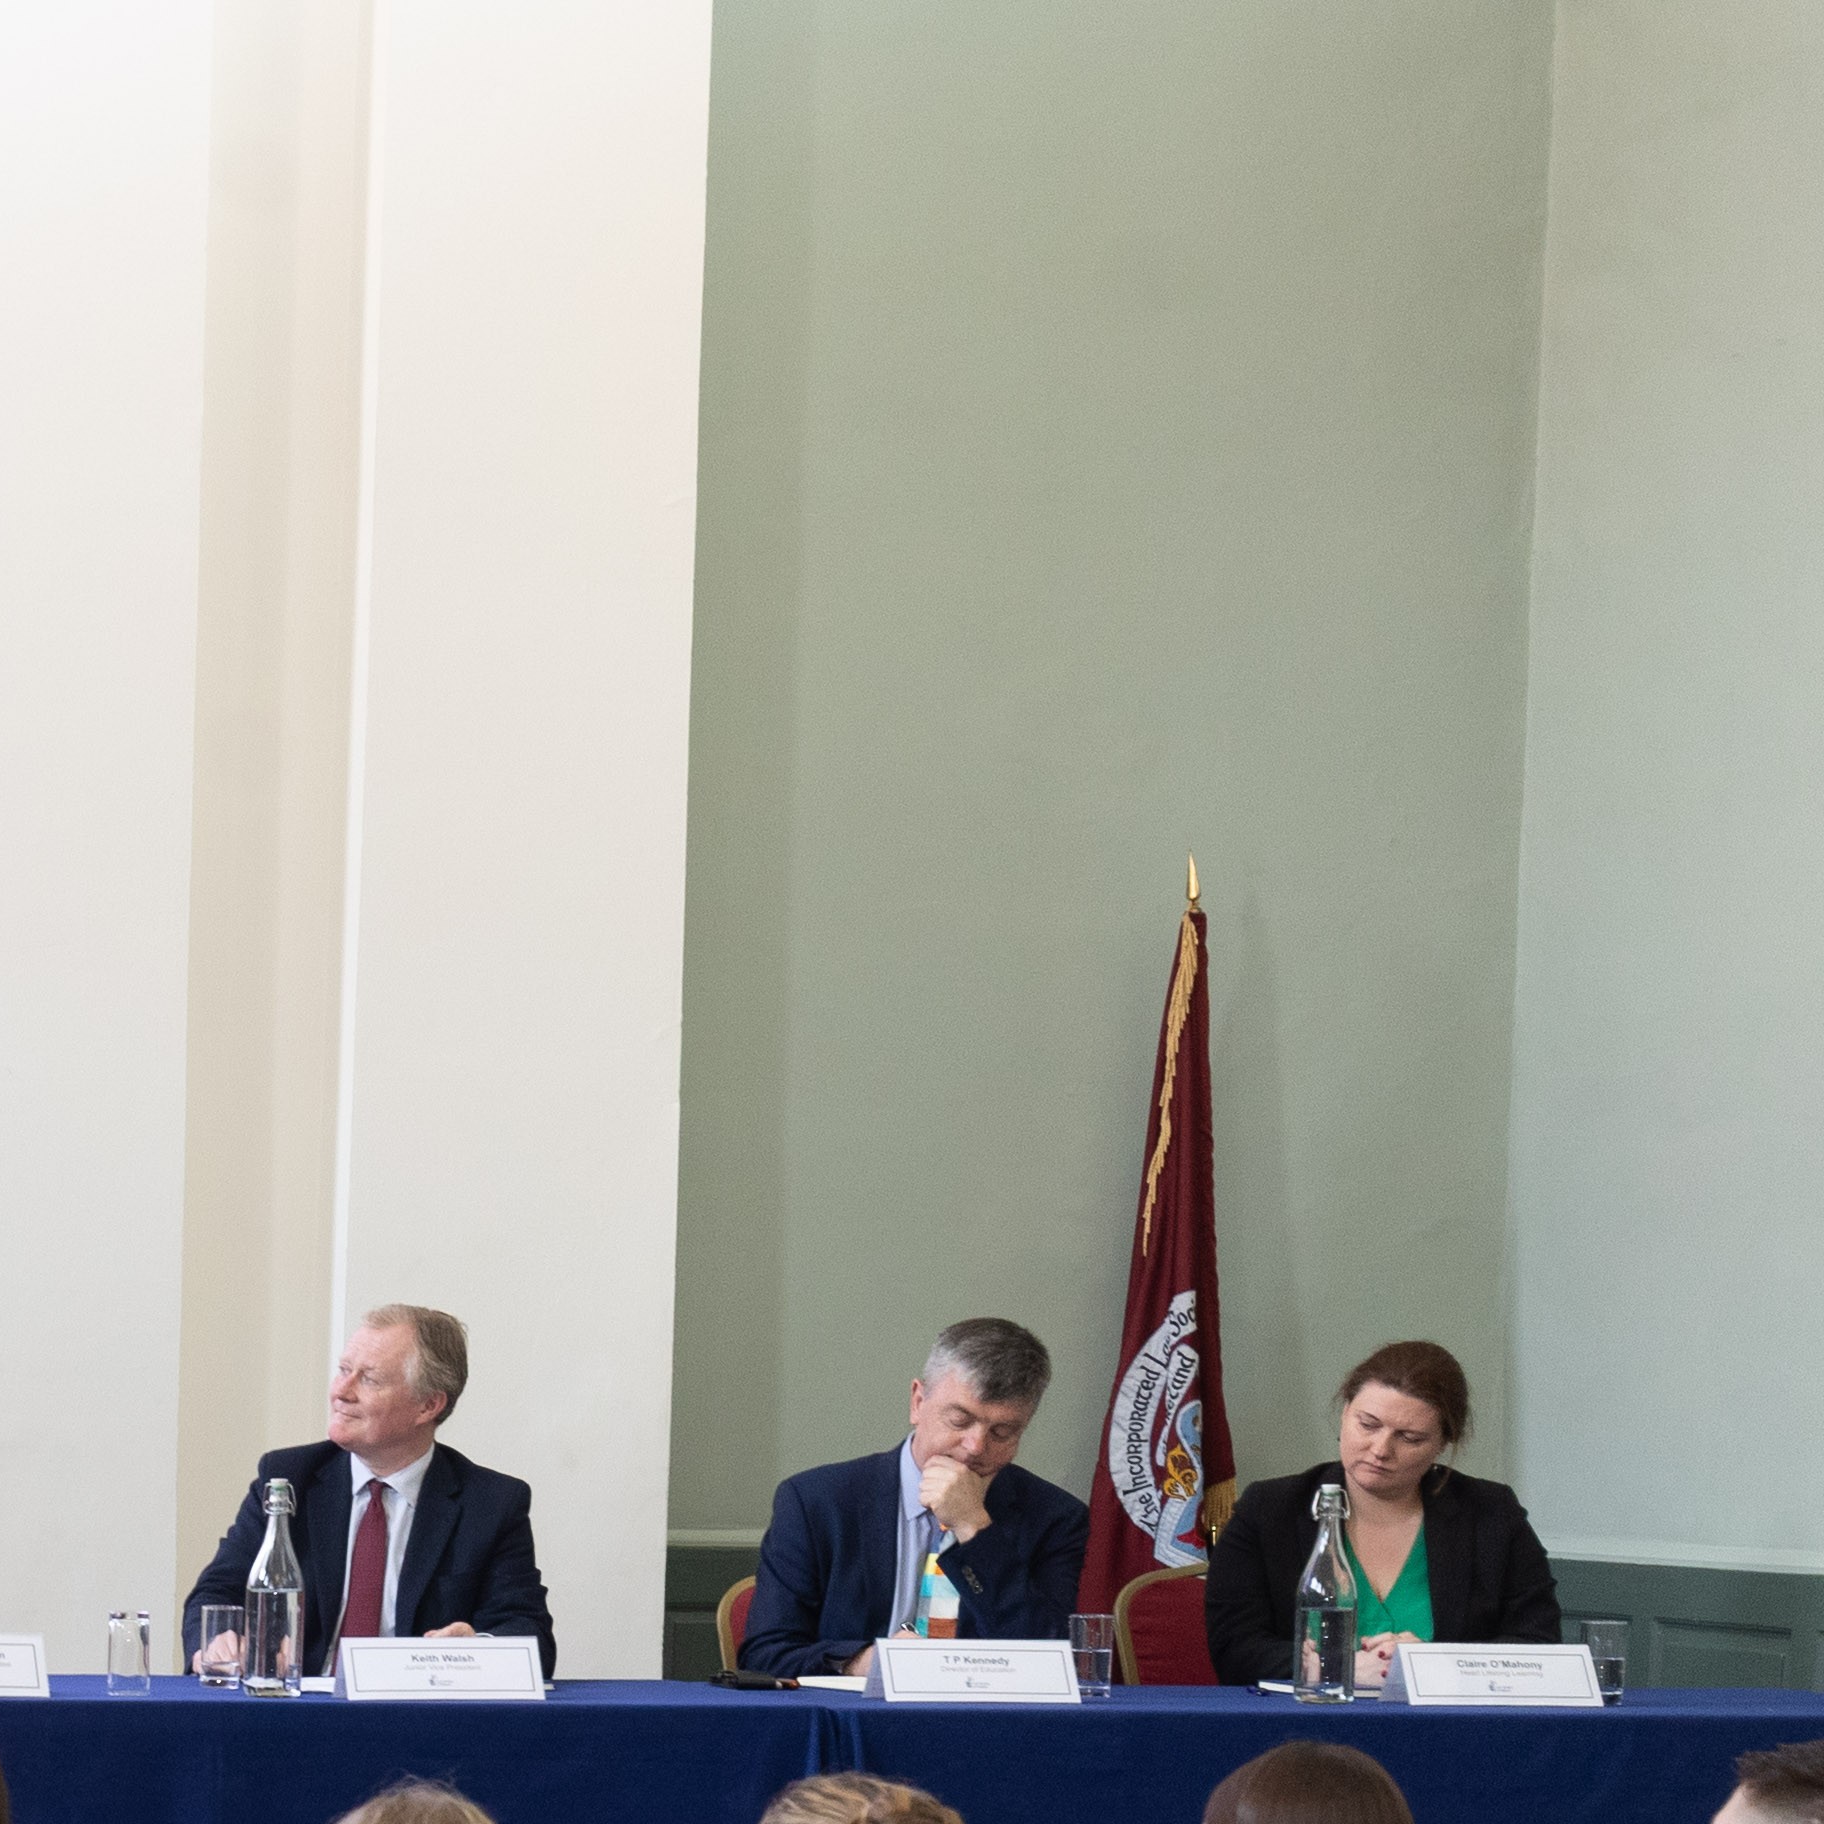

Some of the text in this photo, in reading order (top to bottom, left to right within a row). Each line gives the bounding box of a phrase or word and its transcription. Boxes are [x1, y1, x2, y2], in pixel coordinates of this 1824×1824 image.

[1122, 1364, 1161, 1497] Incorporated
[410, 1653, 475, 1663] Keith Walsh
[943, 1655, 1010, 1667] T P Kennedy
[1456, 1659, 1543, 1671] Claire O'Mahony
